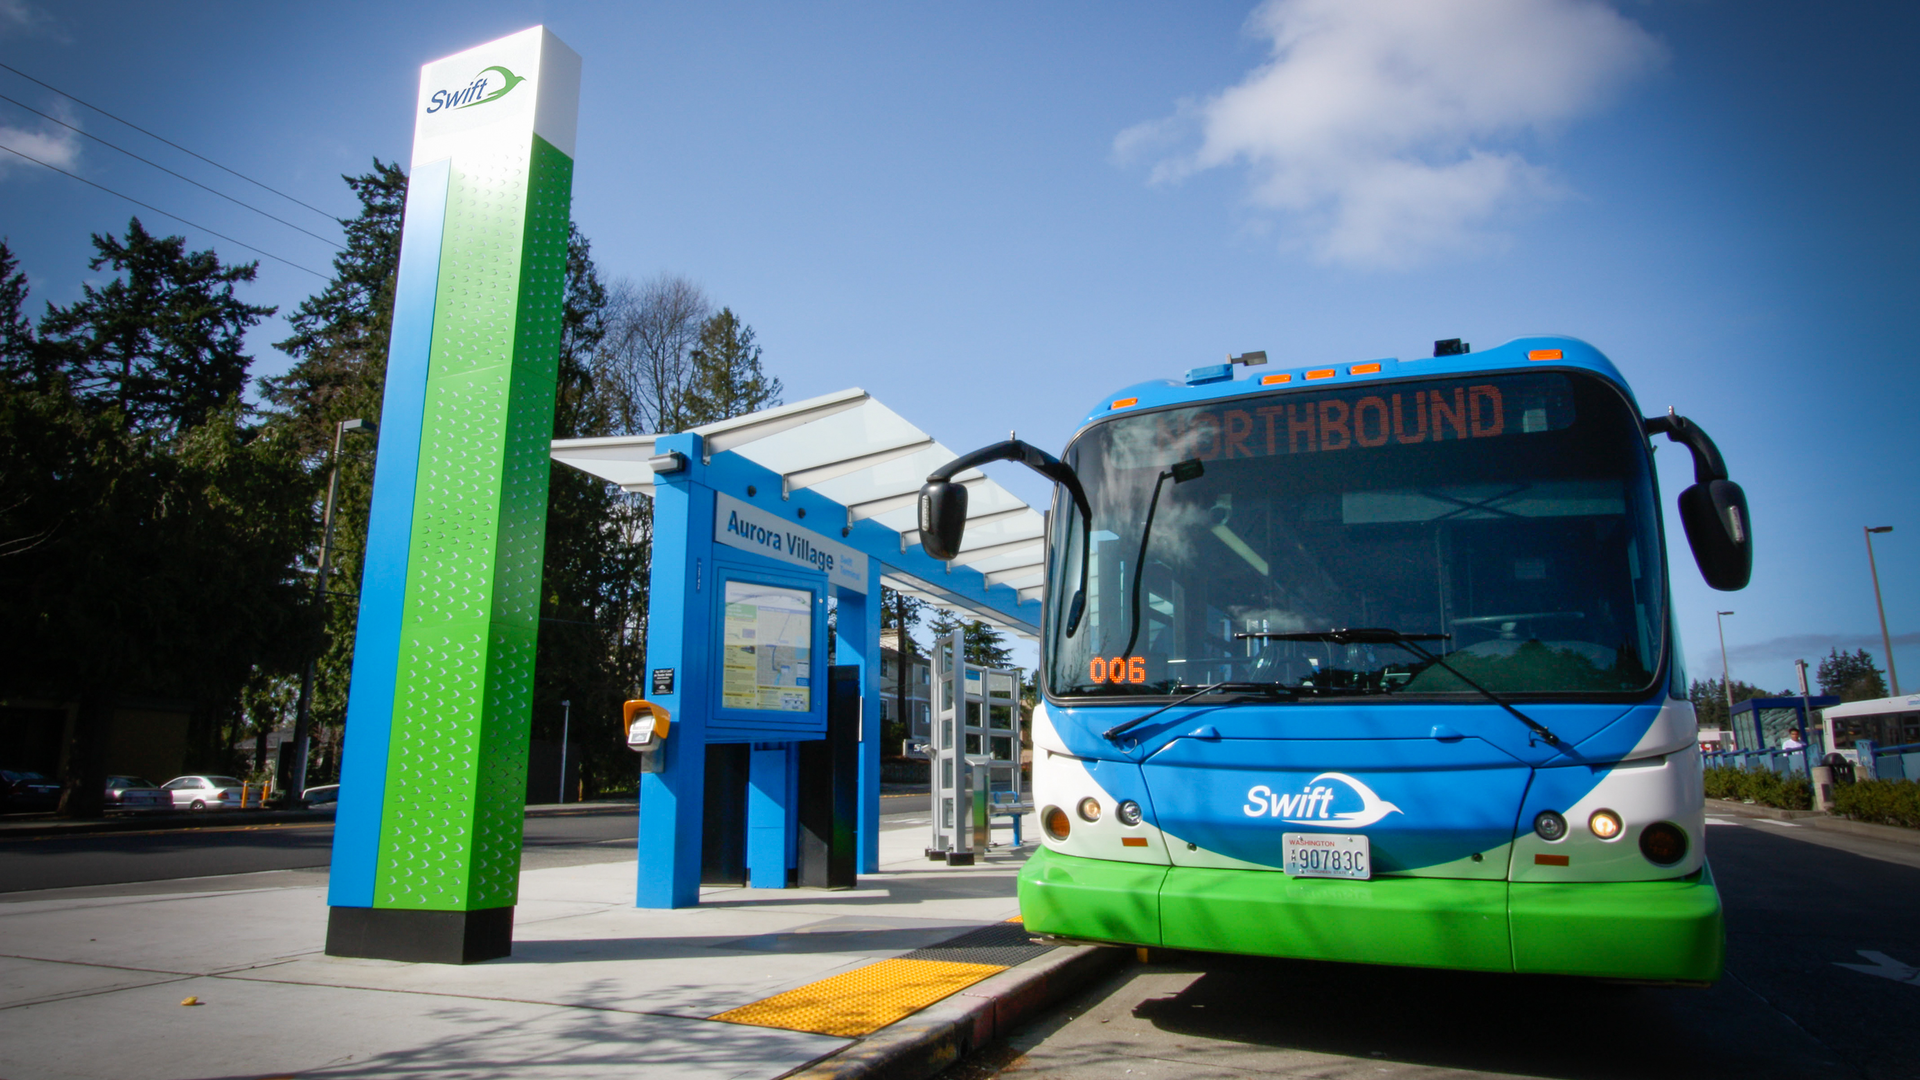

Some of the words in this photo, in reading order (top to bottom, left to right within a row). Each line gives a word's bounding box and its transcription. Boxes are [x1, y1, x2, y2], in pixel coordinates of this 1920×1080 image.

[426, 78, 488, 114] Swift
[1156, 384, 1504, 460] NORTHBOUND
[727, 510, 782, 551] Aurora
[786, 532, 834, 572] Village
[1090, 656, 1146, 684] 006
[1243, 785, 1333, 819] Swift
[1289, 839, 1335, 847] WASHINGTON
[1299, 848, 1364, 872] 90783C
